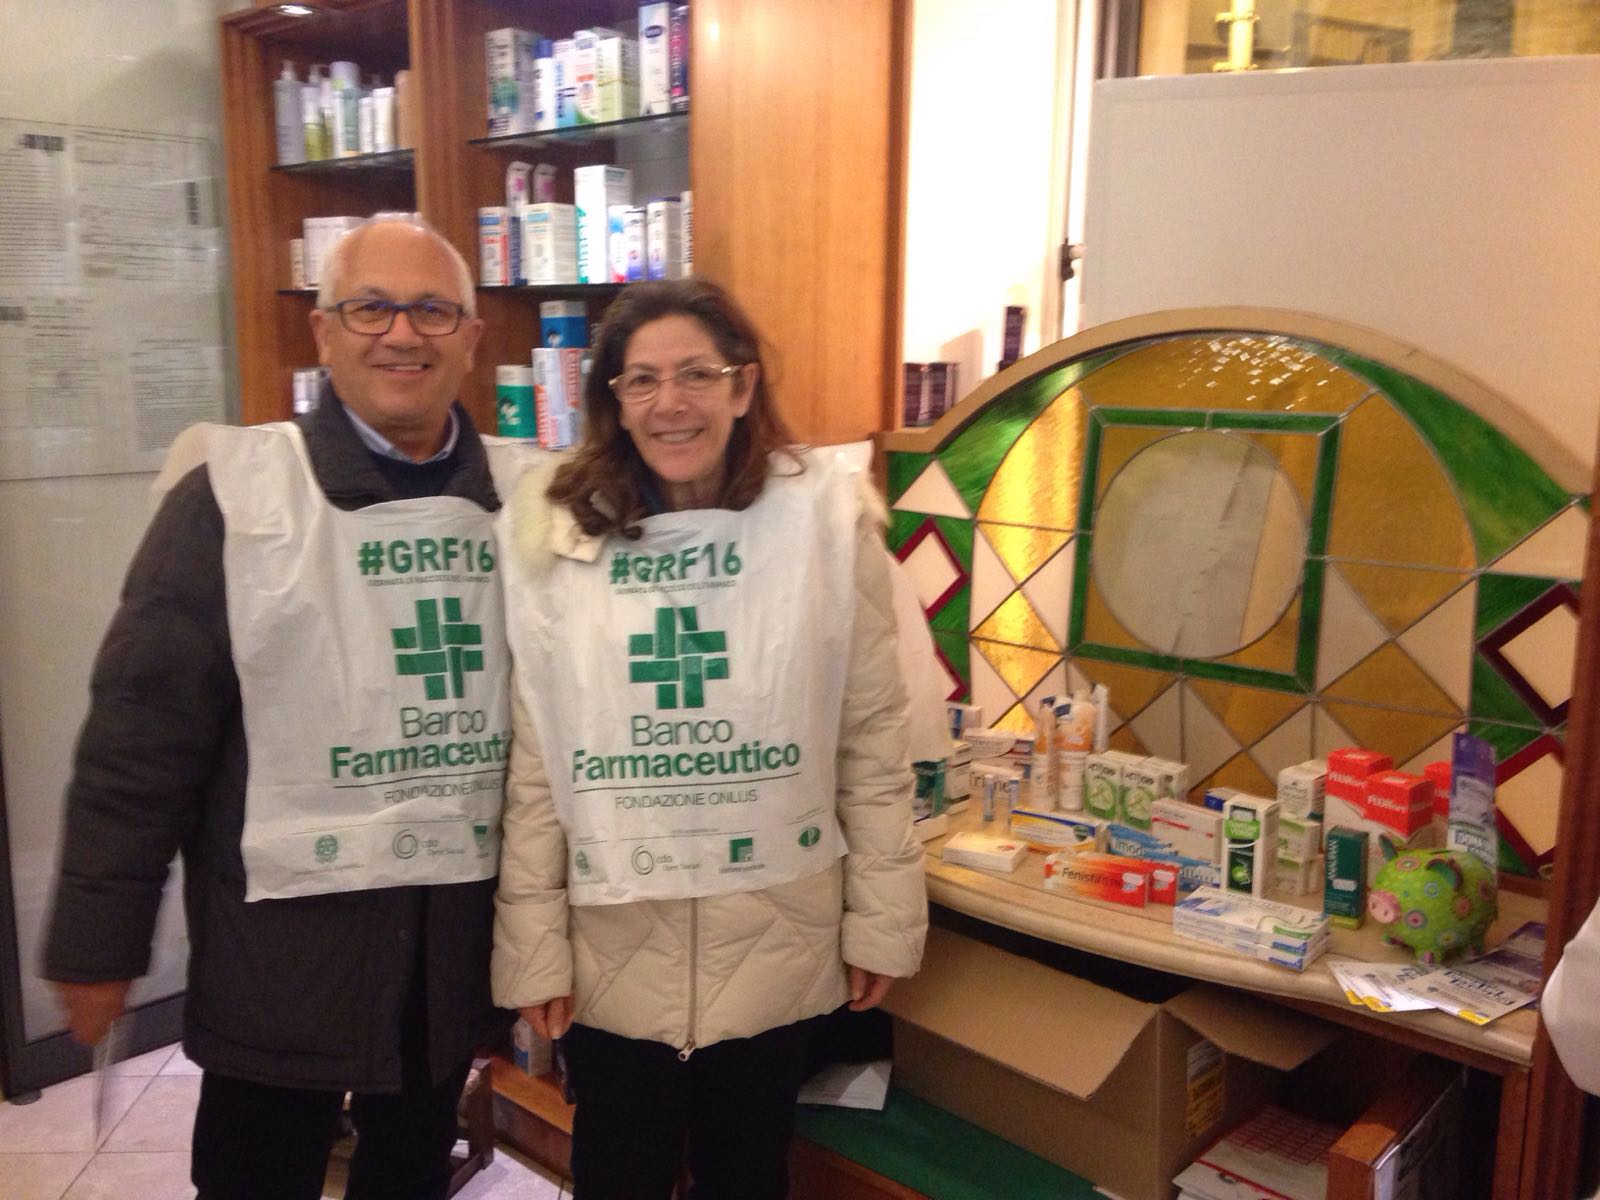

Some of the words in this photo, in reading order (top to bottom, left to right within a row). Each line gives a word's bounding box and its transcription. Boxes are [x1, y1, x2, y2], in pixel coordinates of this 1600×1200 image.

[358, 537, 495, 575] #GRF16
[609, 541, 742, 584] #GRF16
[631, 715, 733, 747] Banco
[572, 740, 800, 783] Farmaceutico
[615, 790, 706, 810] FONDAZIONE
[708, 788, 758, 805] ONLUS
